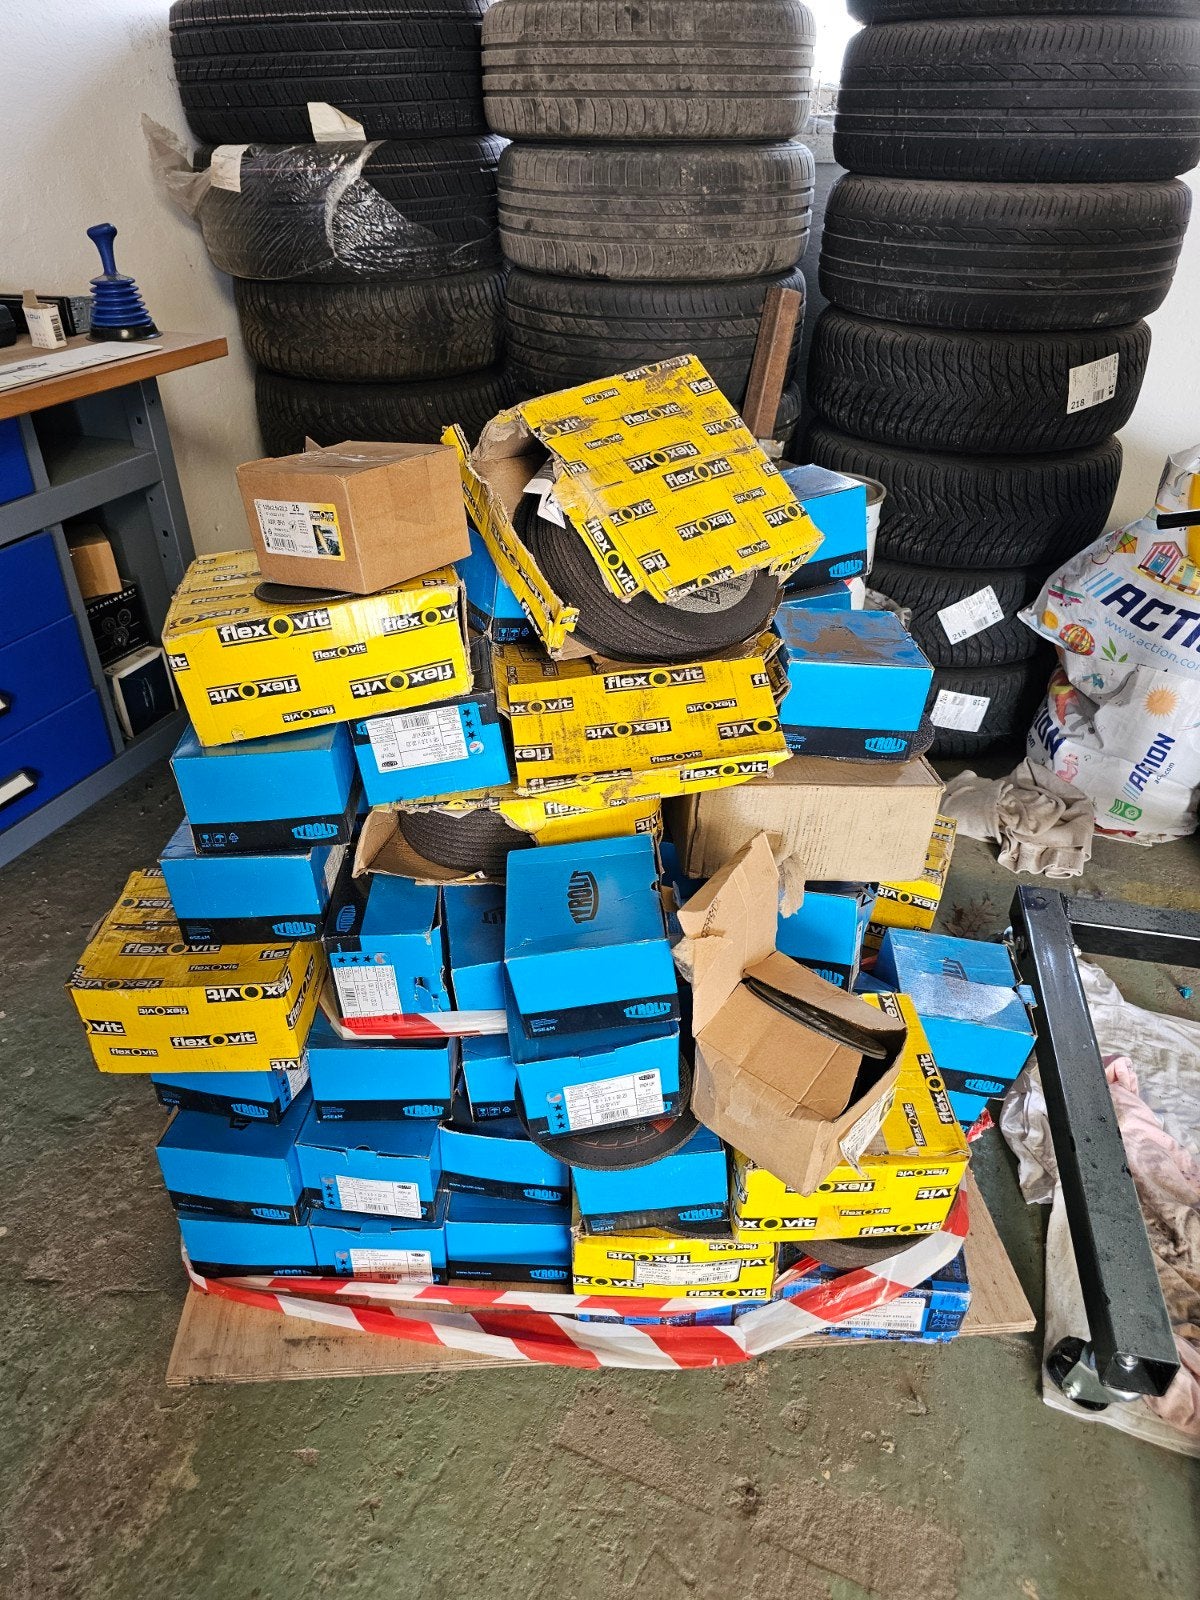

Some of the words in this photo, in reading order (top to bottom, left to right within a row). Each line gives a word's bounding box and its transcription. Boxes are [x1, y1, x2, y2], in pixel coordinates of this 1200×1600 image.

[1071, 399, 1085, 409] 218
[829, 559, 864, 578] TYROLIT
[1100, 583, 1200, 652] ACTI
[952, 630, 967, 640] 218
[864, 737, 908, 754] TYROLIT
[291, 823, 339, 840] TYROLIT
[567, 870, 600, 924] TYROLIT
[272, 921, 317, 937] TYROLIT
[623, 1001, 671, 1020] TYROLIT
[965, 1078, 1004, 1093] TYROLIT
[231, 1103, 269, 1118] TYROLIT
[402, 1104, 444, 1118] TYROLIT
[523, 1188, 563, 1201] TYROLIT
[251, 1207, 290, 1220] TYROLIT
[678, 1208, 723, 1221] TYROLIT
[530, 1269, 568, 1281] TYROLIT
